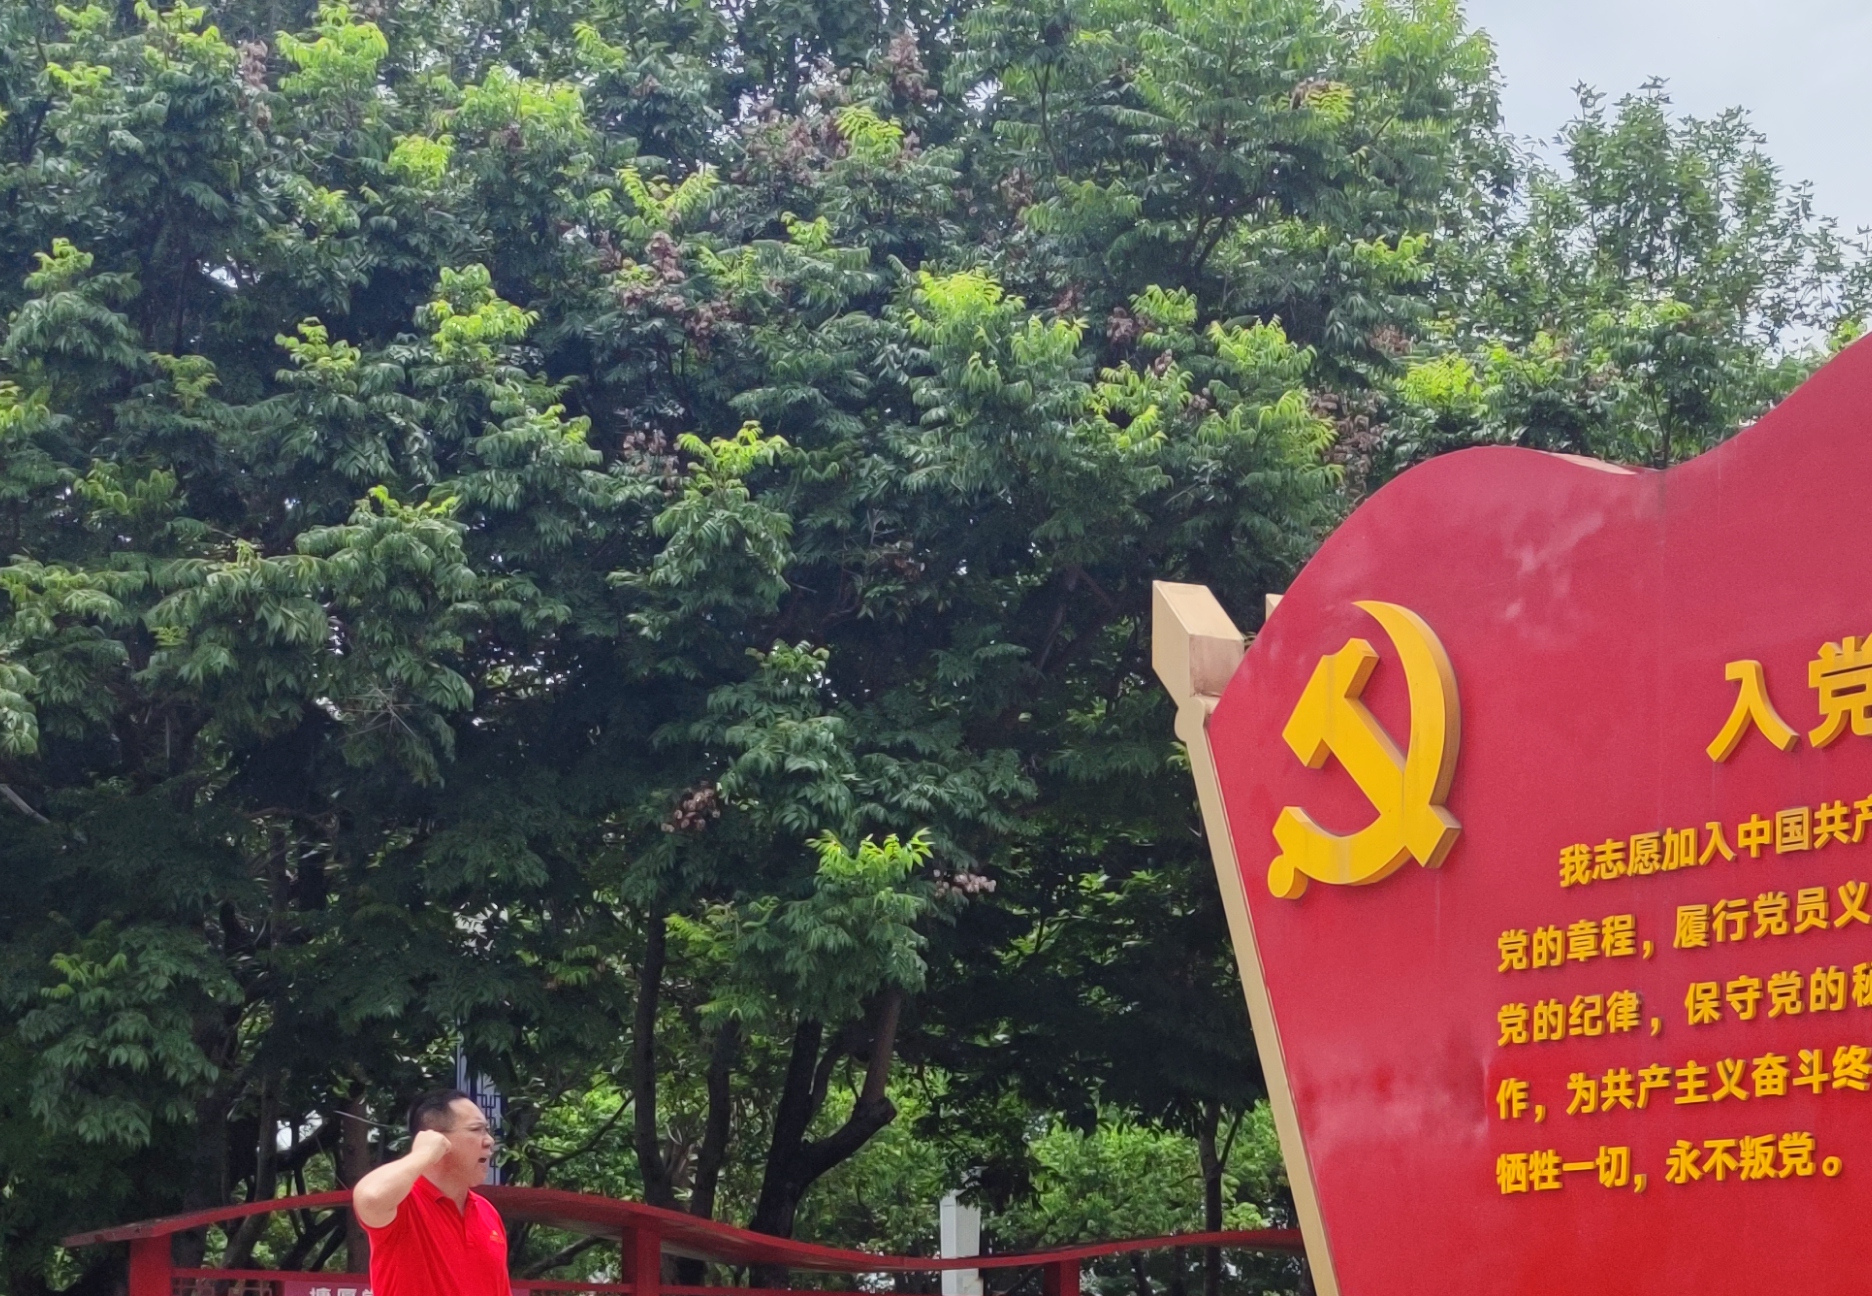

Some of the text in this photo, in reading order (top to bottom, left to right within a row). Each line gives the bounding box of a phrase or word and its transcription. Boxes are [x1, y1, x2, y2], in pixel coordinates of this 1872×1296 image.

[1495, 1131, 1844, 1194] 牺牲一切，永不叛党。
